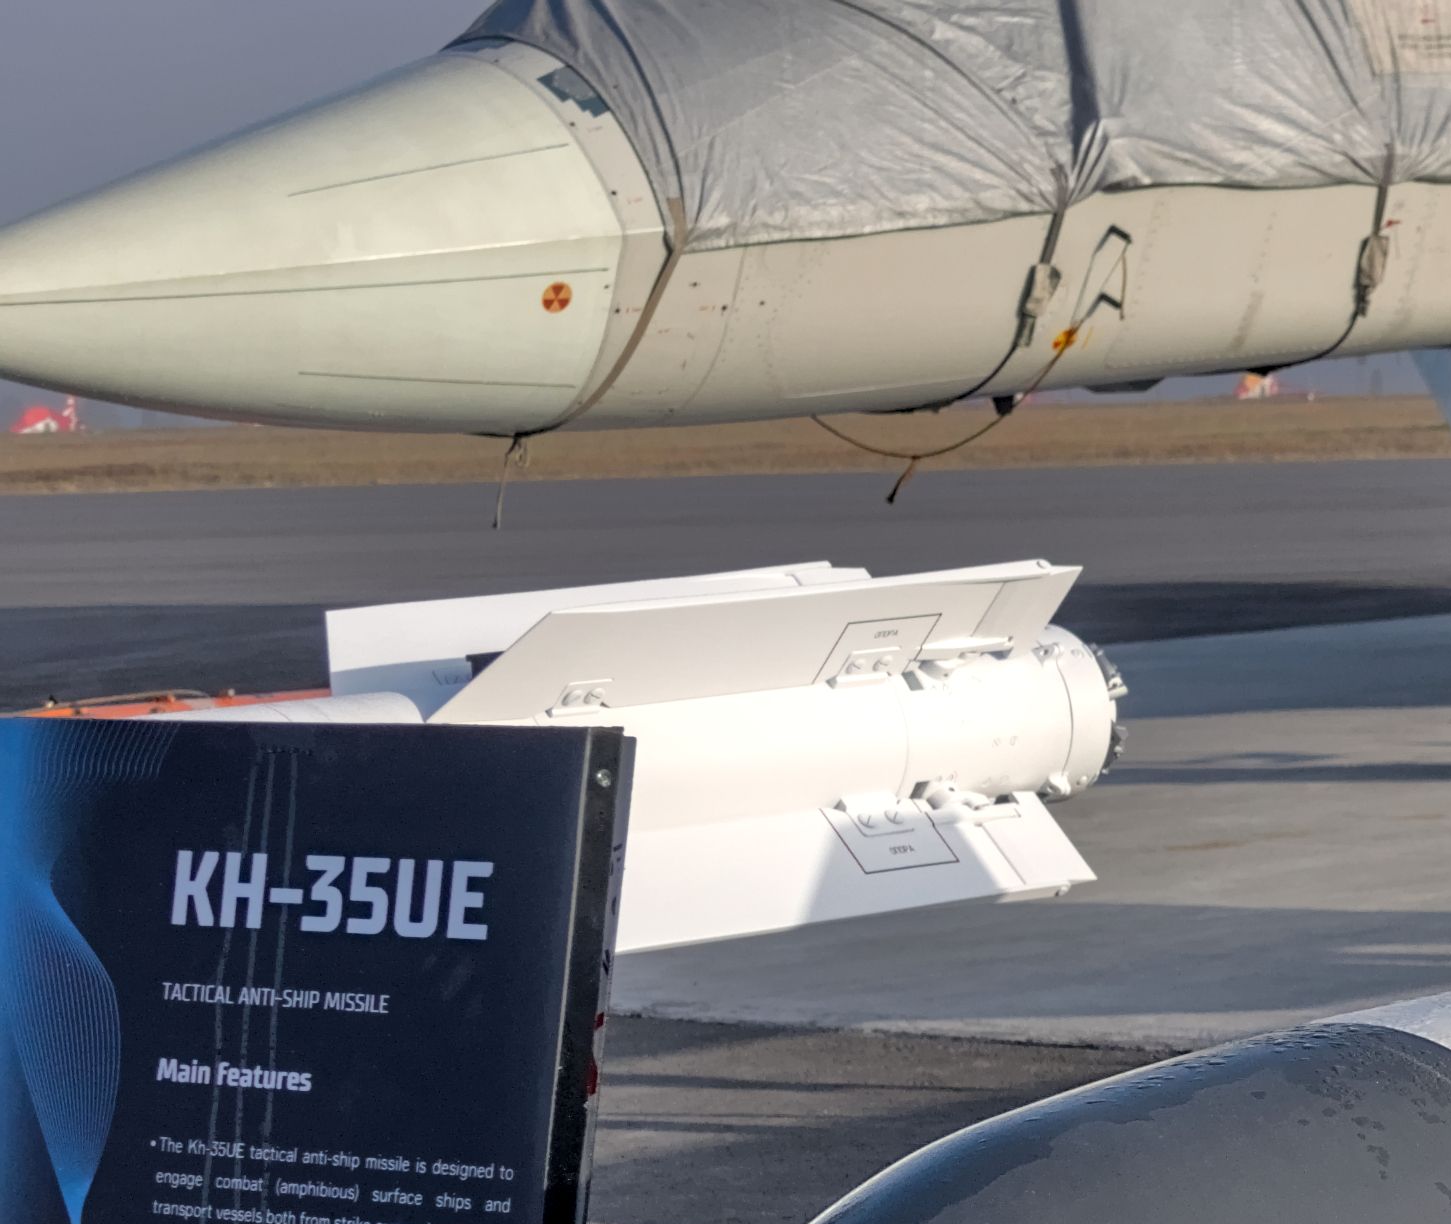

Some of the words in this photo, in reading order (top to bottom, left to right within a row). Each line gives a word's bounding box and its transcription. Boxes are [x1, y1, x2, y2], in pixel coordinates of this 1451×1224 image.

[170, 848, 495, 940] KH-35UE
[162, 982, 235, 1005] TACTICAL
[238, 986, 320, 1009] ANTI-SHIP
[323, 991, 390, 1014] MISSILE
[156, 1057, 211, 1085] Main
[159, 1136, 183, 1154] The
[187, 1139, 245, 1159] Kh-35UE
[250, 1145, 298, 1163] tactical
[302, 1150, 360, 1171] anti-ship
[365, 1154, 411, 1172] missile
[415, 1157, 427, 1174] is
[432, 1159, 494, 1181] designed
[499, 1165, 514, 1181] to
[155, 1171, 203, 1190] engage
[215, 1175, 264, 1191] combat
[275, 1178, 360, 1202] (amphibious)
[372, 1188, 423, 1206] surface
[435, 1192, 472, 1212] ships
[484, 1198, 511, 1213] and
[152, 1200, 212, 1220] transport
[216, 1208, 263, 1224] vessels
